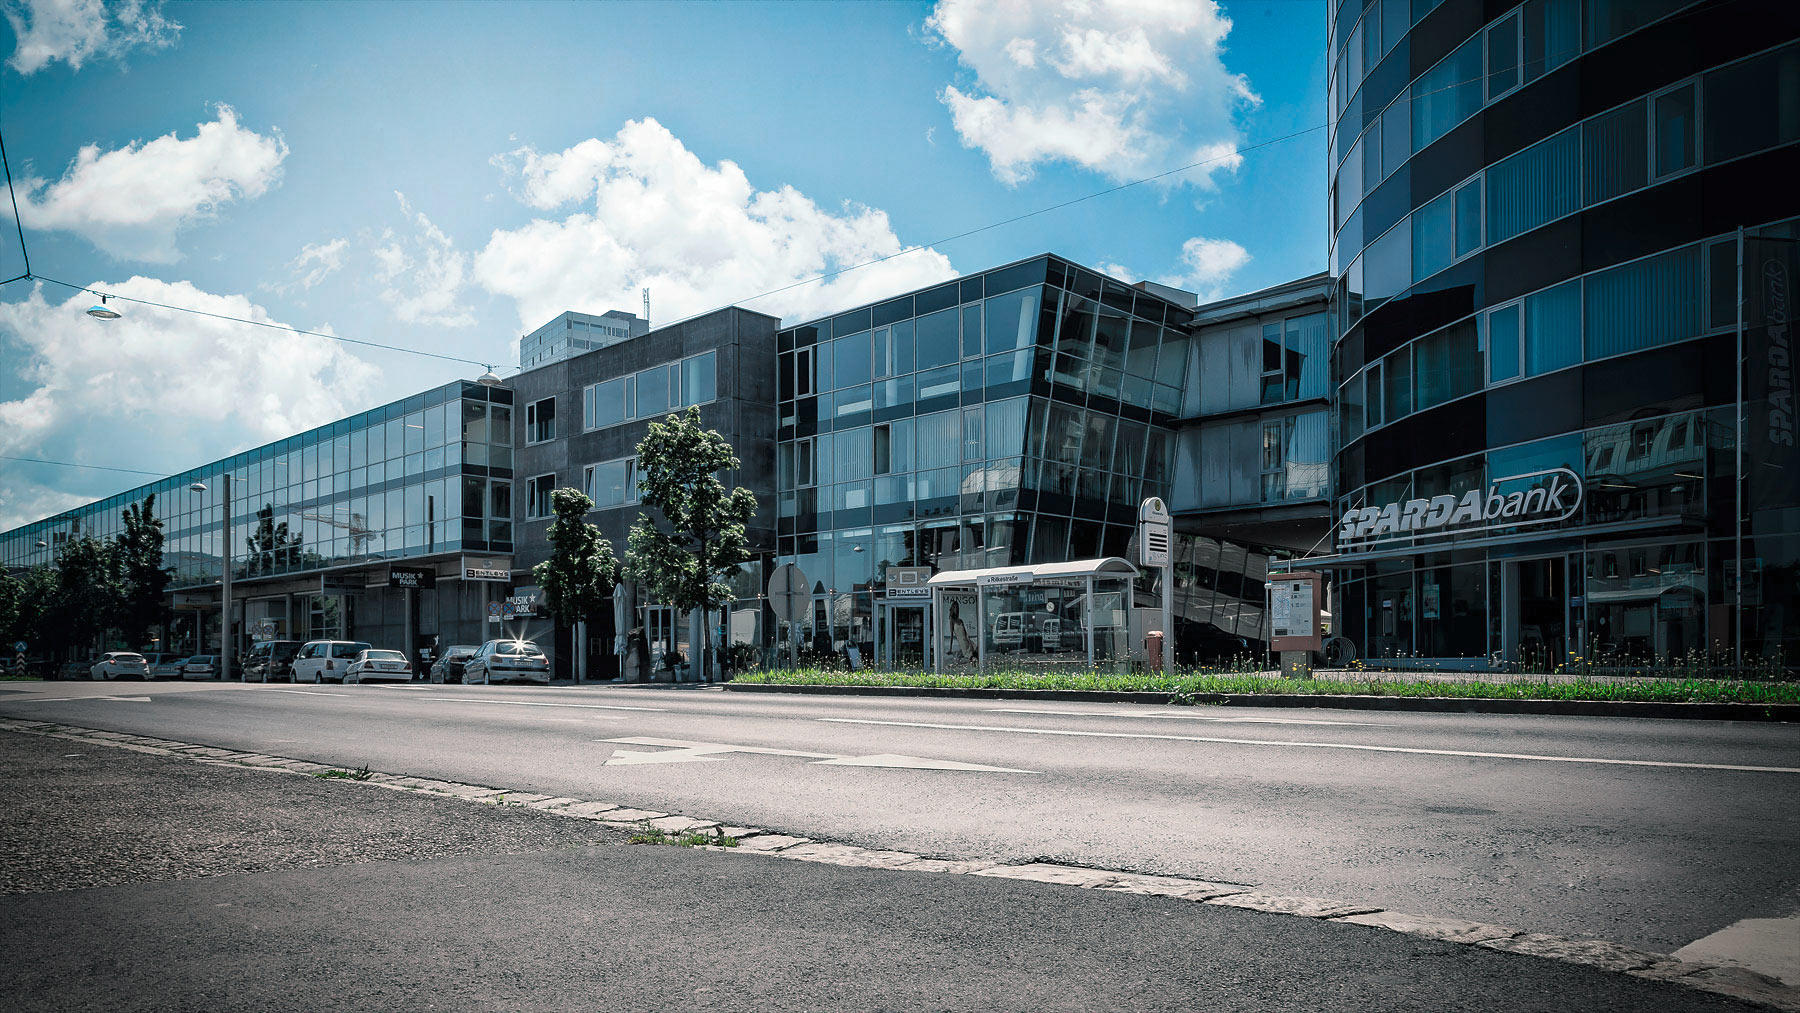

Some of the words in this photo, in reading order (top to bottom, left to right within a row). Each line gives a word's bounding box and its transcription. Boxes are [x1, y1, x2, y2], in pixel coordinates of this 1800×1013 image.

[392, 571, 416, 579] MUSIK
[943, 596, 976, 604] MANGO
[514, 604, 531, 613] ARK
